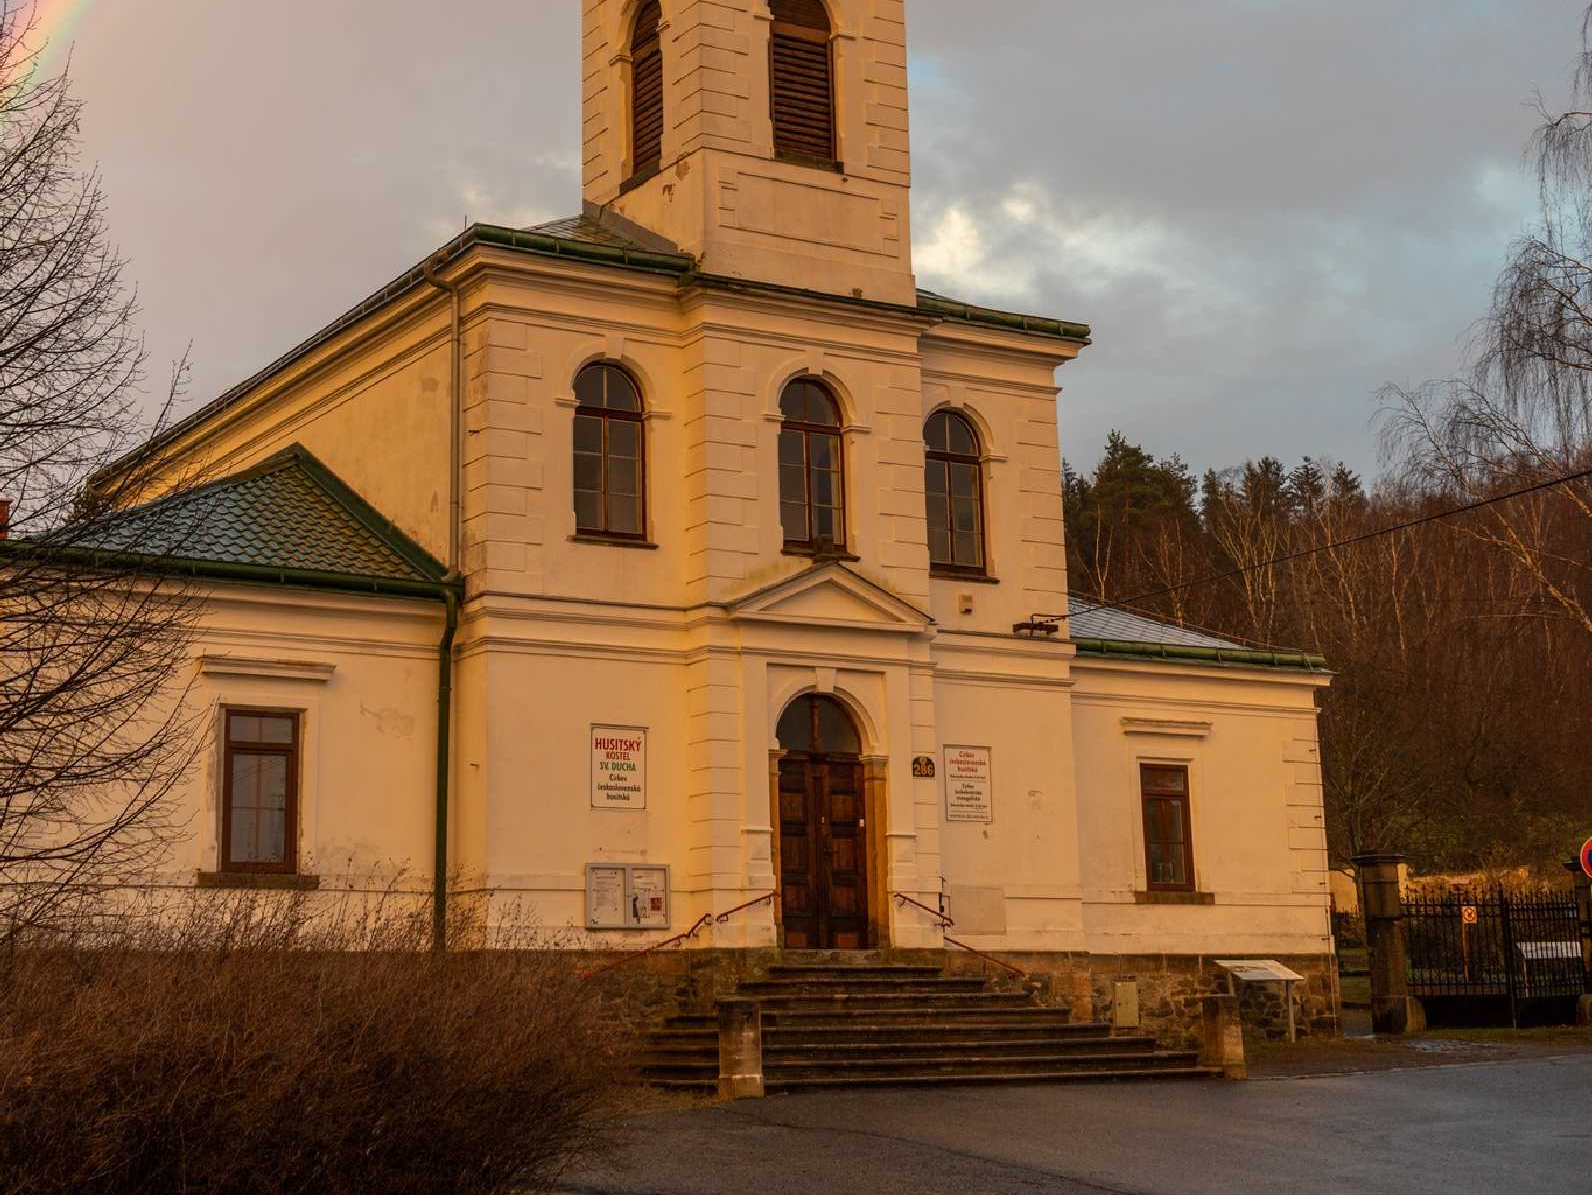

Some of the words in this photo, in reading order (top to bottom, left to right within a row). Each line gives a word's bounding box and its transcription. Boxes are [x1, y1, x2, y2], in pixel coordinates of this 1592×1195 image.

[594, 736, 642, 752] HUSITSKÝ
[606, 751, 630, 760] KOSTEL
[612, 762, 636, 772] DUCHA
